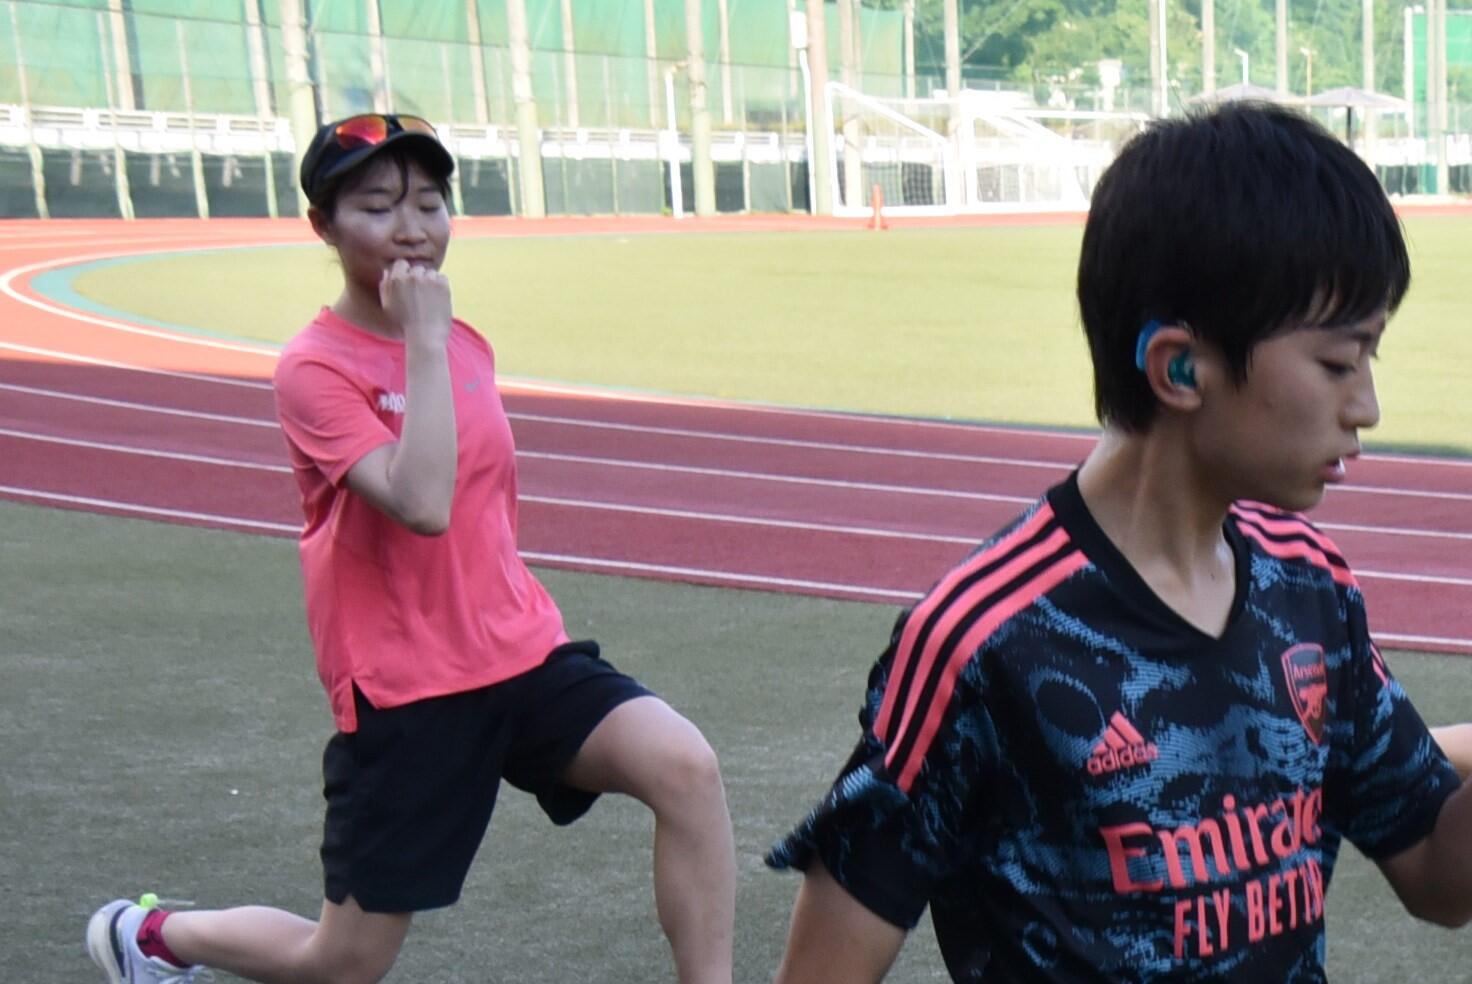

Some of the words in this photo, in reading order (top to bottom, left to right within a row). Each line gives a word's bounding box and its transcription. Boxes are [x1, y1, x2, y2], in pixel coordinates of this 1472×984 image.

[1087, 741, 1159, 776] adidas
[1099, 785, 1323, 894] Emirate
[1173, 887, 1231, 959] FLY
